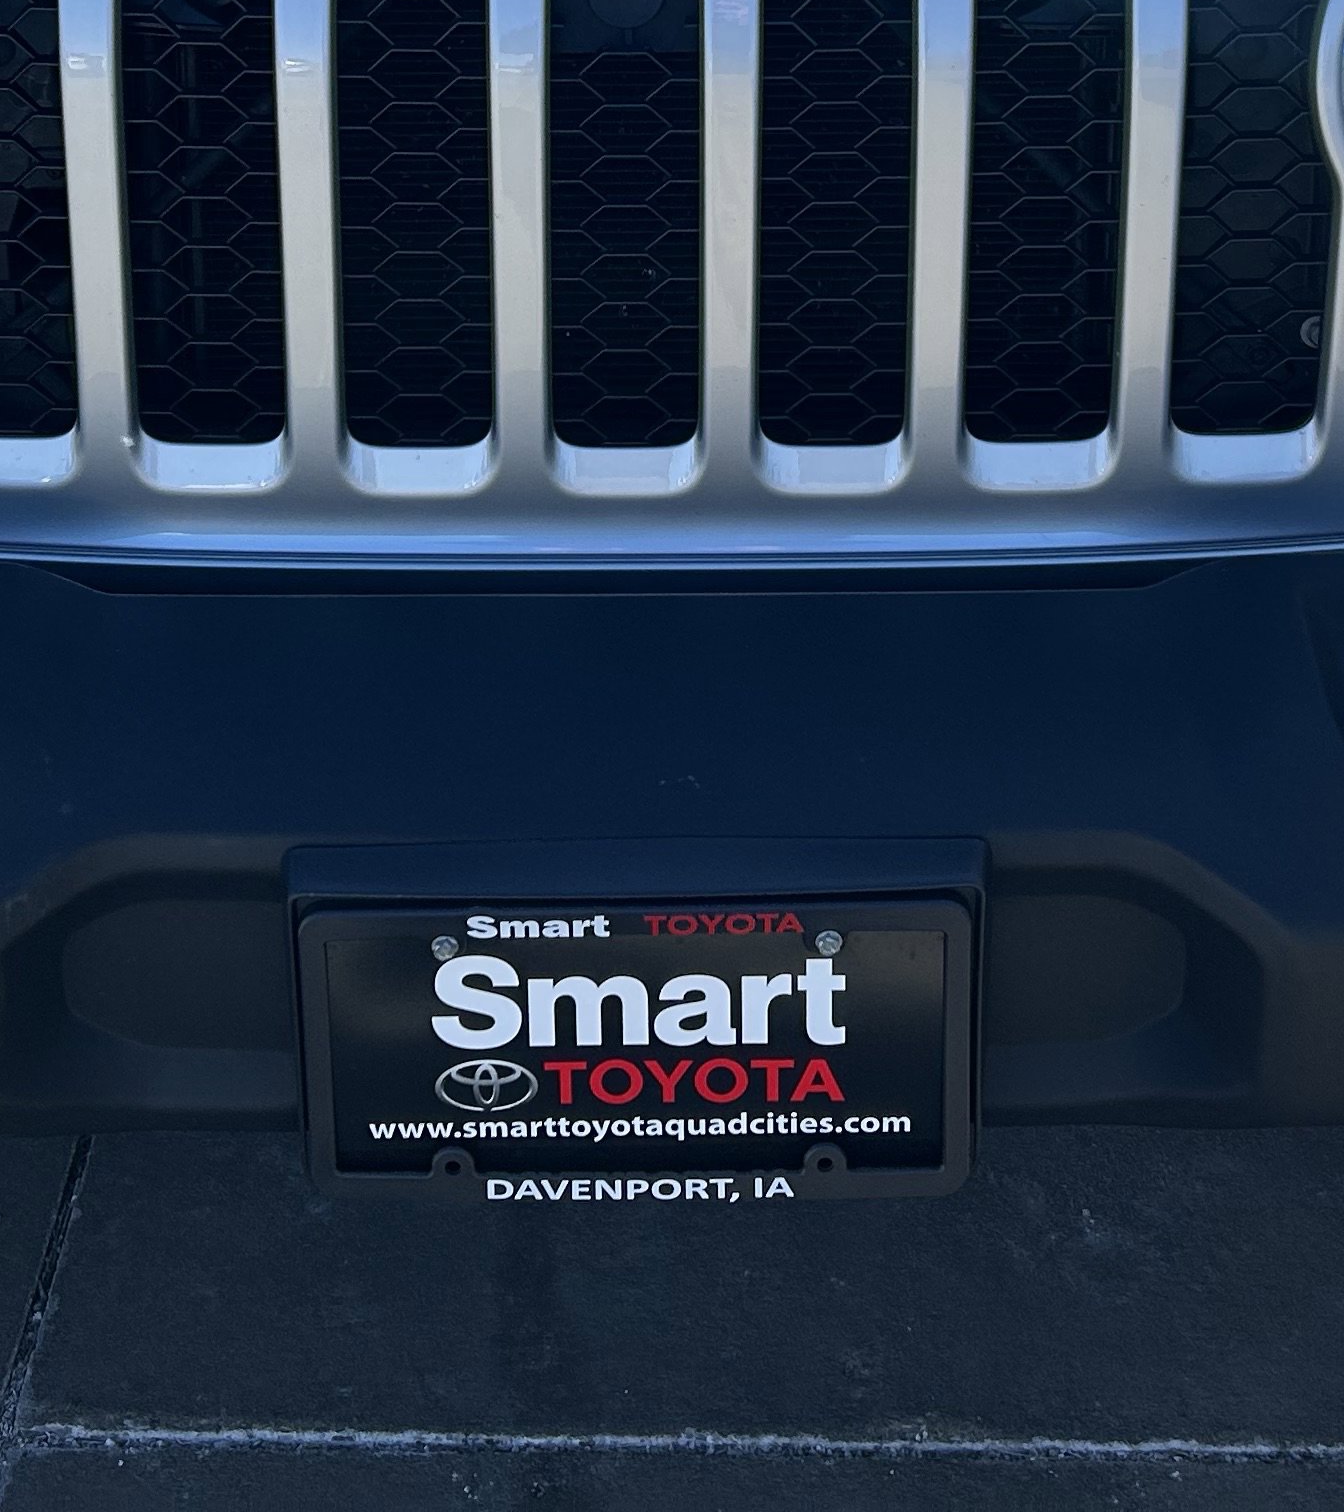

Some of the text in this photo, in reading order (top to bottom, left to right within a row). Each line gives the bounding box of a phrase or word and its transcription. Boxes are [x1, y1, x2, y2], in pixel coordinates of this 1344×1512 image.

[466, 913, 805, 939] Smart TOYOTA
[431, 954, 847, 1051] Smart
[544, 1058, 845, 1105] TOYOTA
[369, 1111, 912, 1142] www.smarttoyotaquadcities.com
[486, 1176, 795, 1203] DAVENPORT, IA
